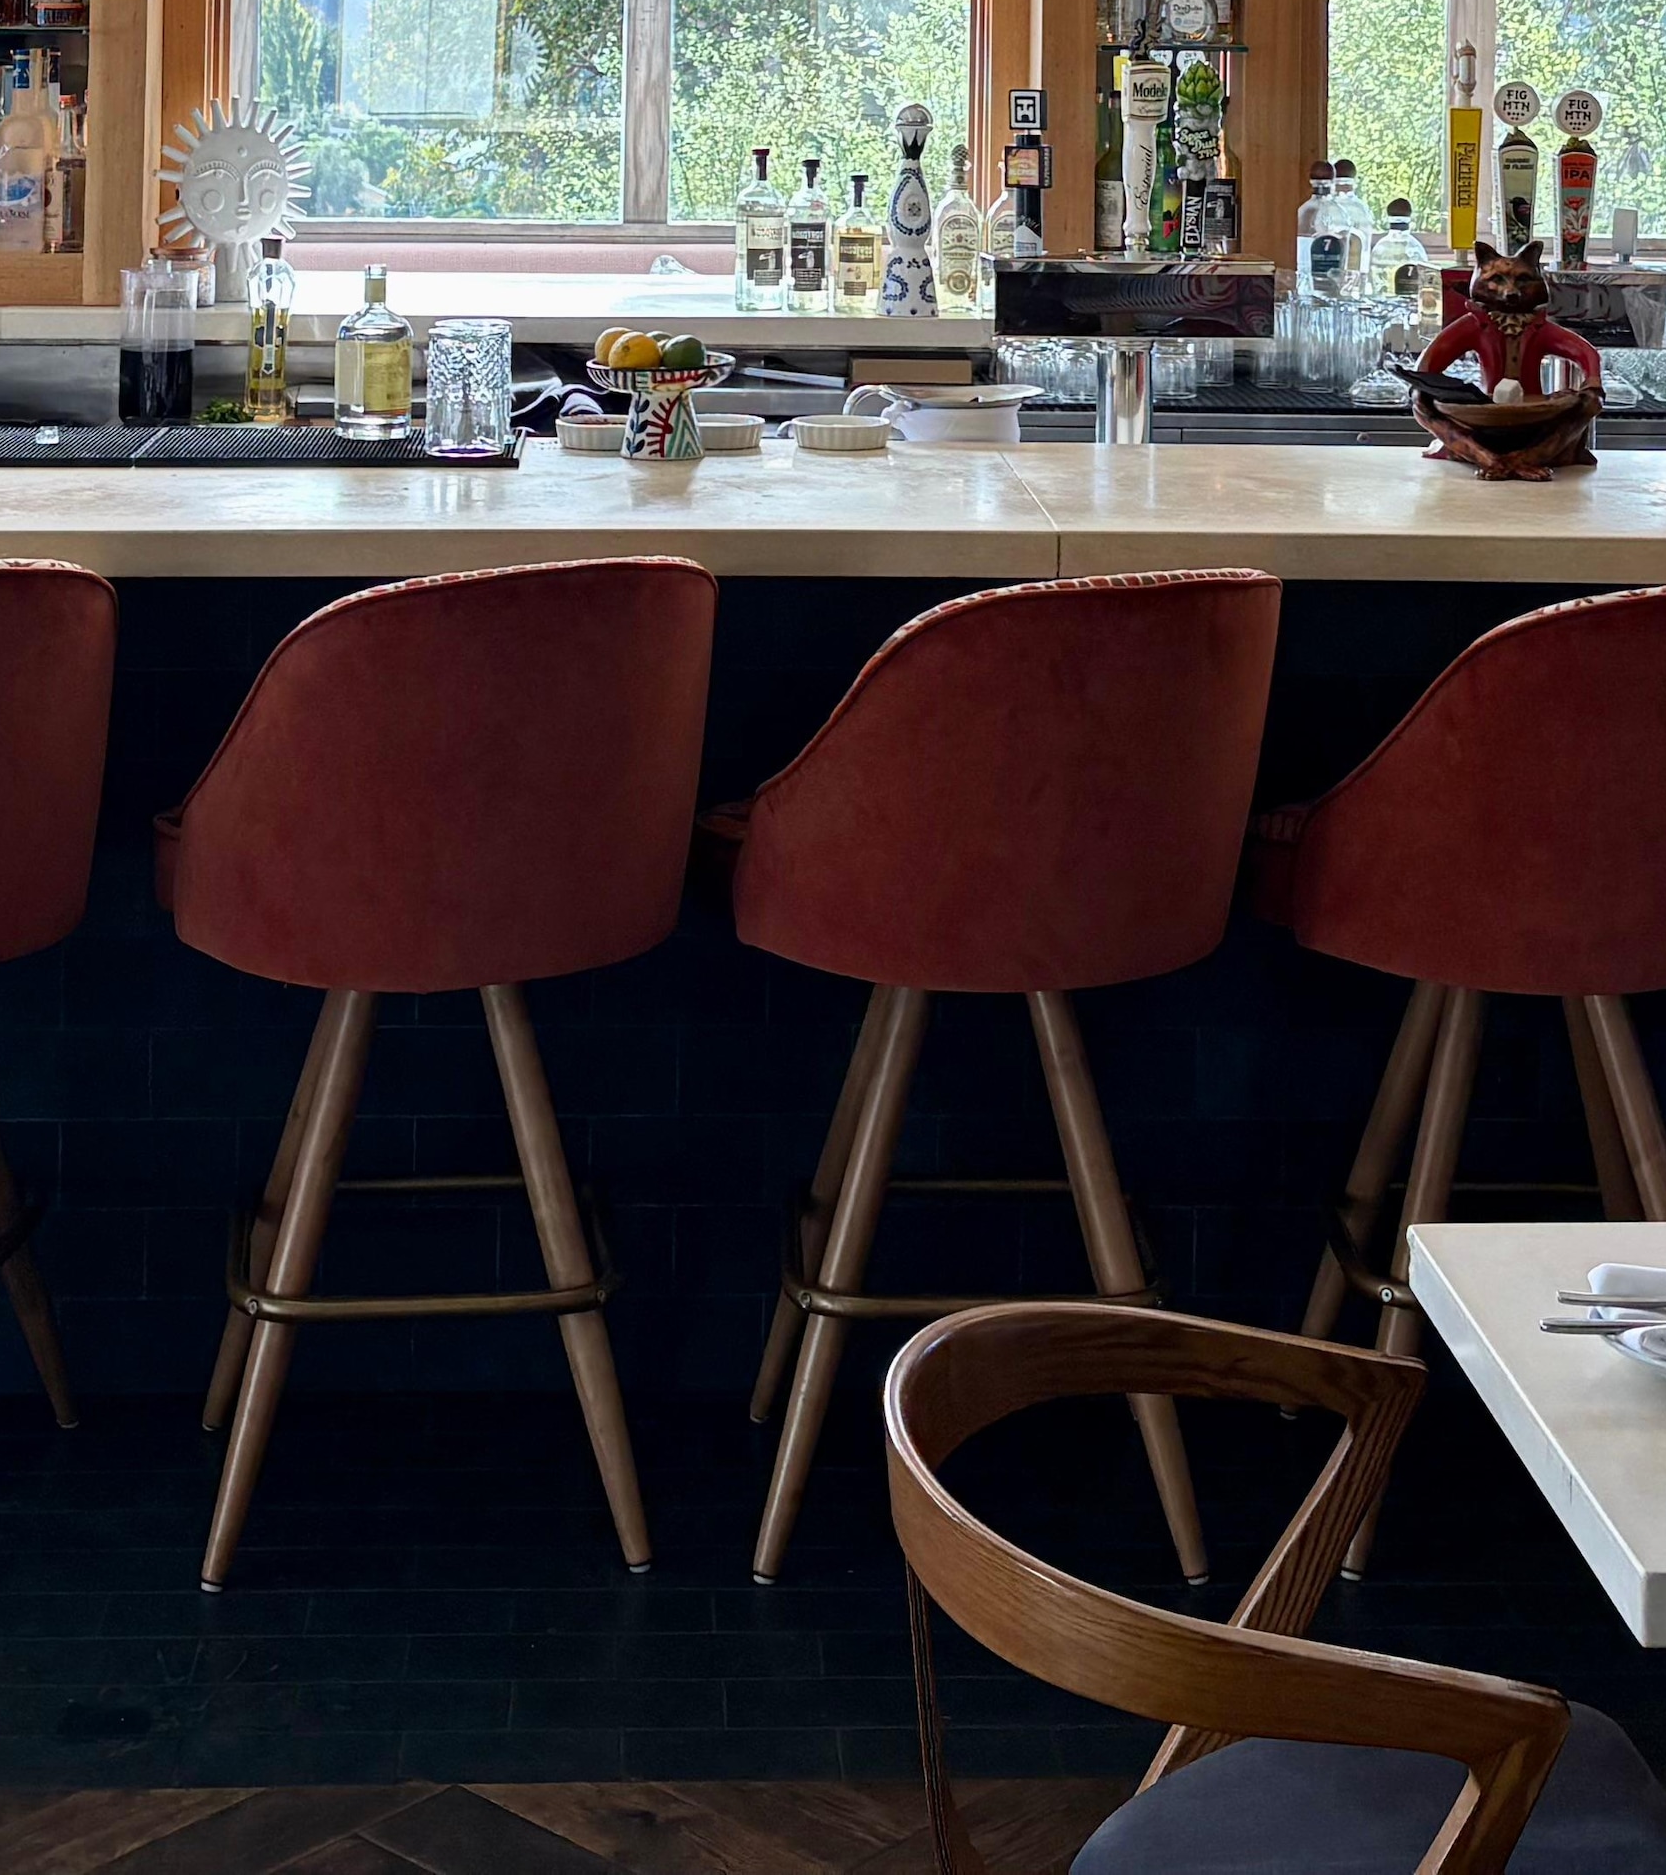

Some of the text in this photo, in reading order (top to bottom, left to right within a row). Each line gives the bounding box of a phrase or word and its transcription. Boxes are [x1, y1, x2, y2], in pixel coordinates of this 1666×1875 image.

[1506, 89, 1528, 100] FIG
[1503, 101, 1530, 112] MTN
[1568, 99, 1589, 110] FIG
[1564, 110, 1592, 122] MTN
[1179, 128, 1209, 145] Space
[1191, 137, 1217, 153] Dust
[1134, 144, 1152, 211] Especial
[1564, 169, 1590, 180] IPA
[1185, 196, 1202, 245] ELYSIAN
[1323, 239, 1331, 251] 7
[1407, 266, 1413, 276] 7
